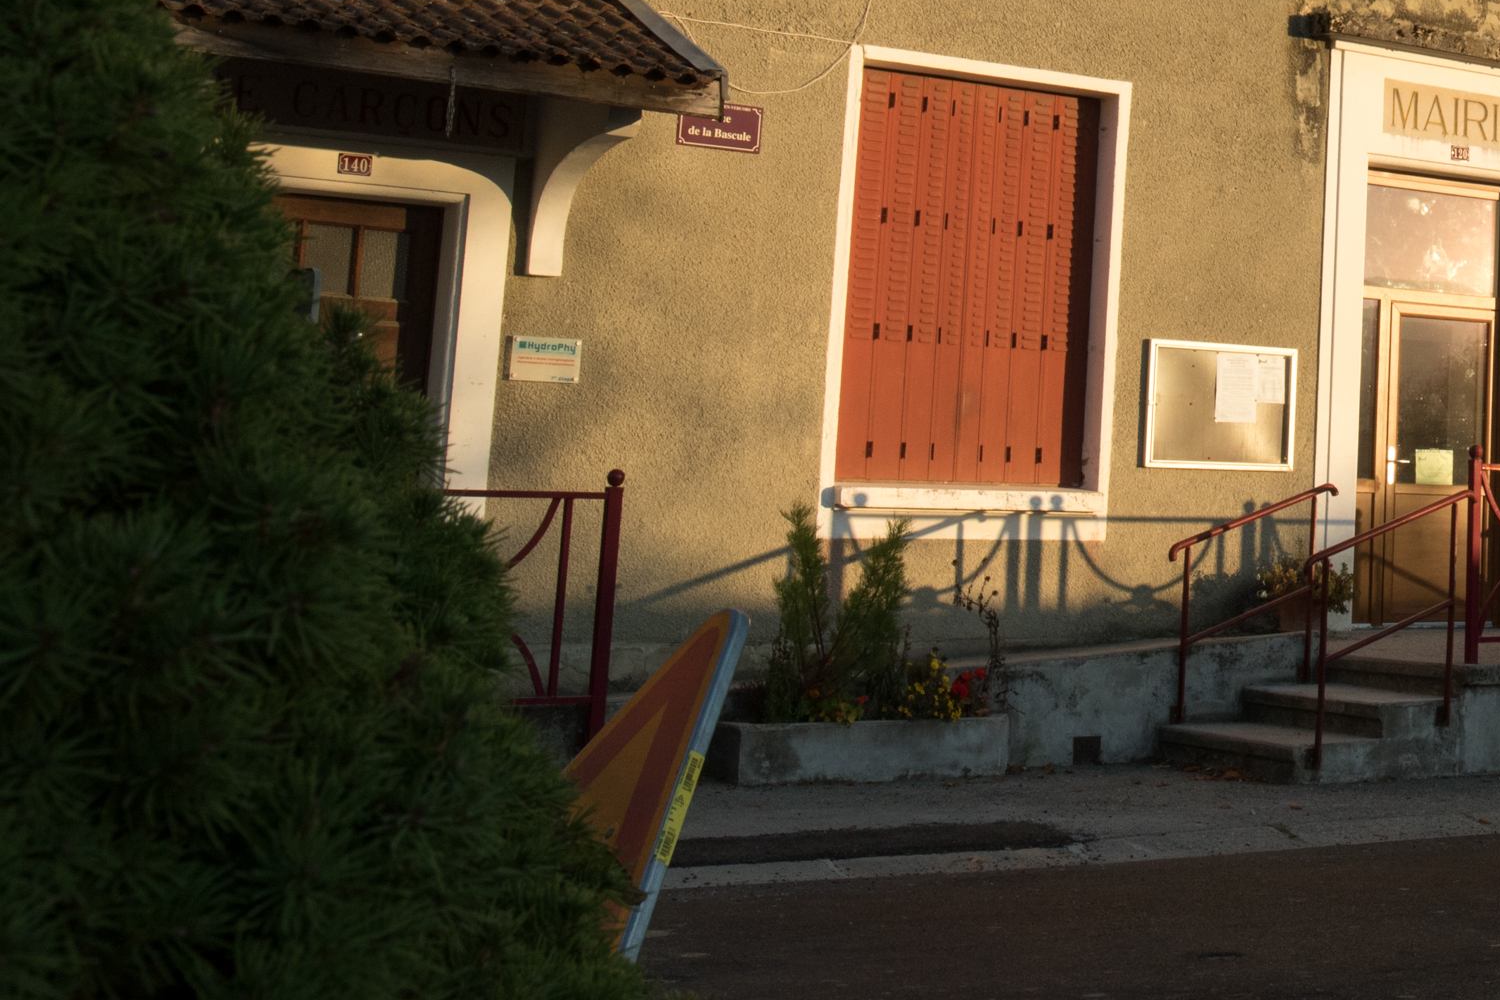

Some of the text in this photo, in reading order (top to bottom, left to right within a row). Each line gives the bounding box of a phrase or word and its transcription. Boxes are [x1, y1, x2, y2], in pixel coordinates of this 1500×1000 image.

[292, 80, 513, 140] GARÇONS
[687, 125, 752, 142] de la Bascule
[1453, 147, 1468, 160] 120
[342, 156, 369, 174] 140
[527, 341, 576, 355] HydroPhy
